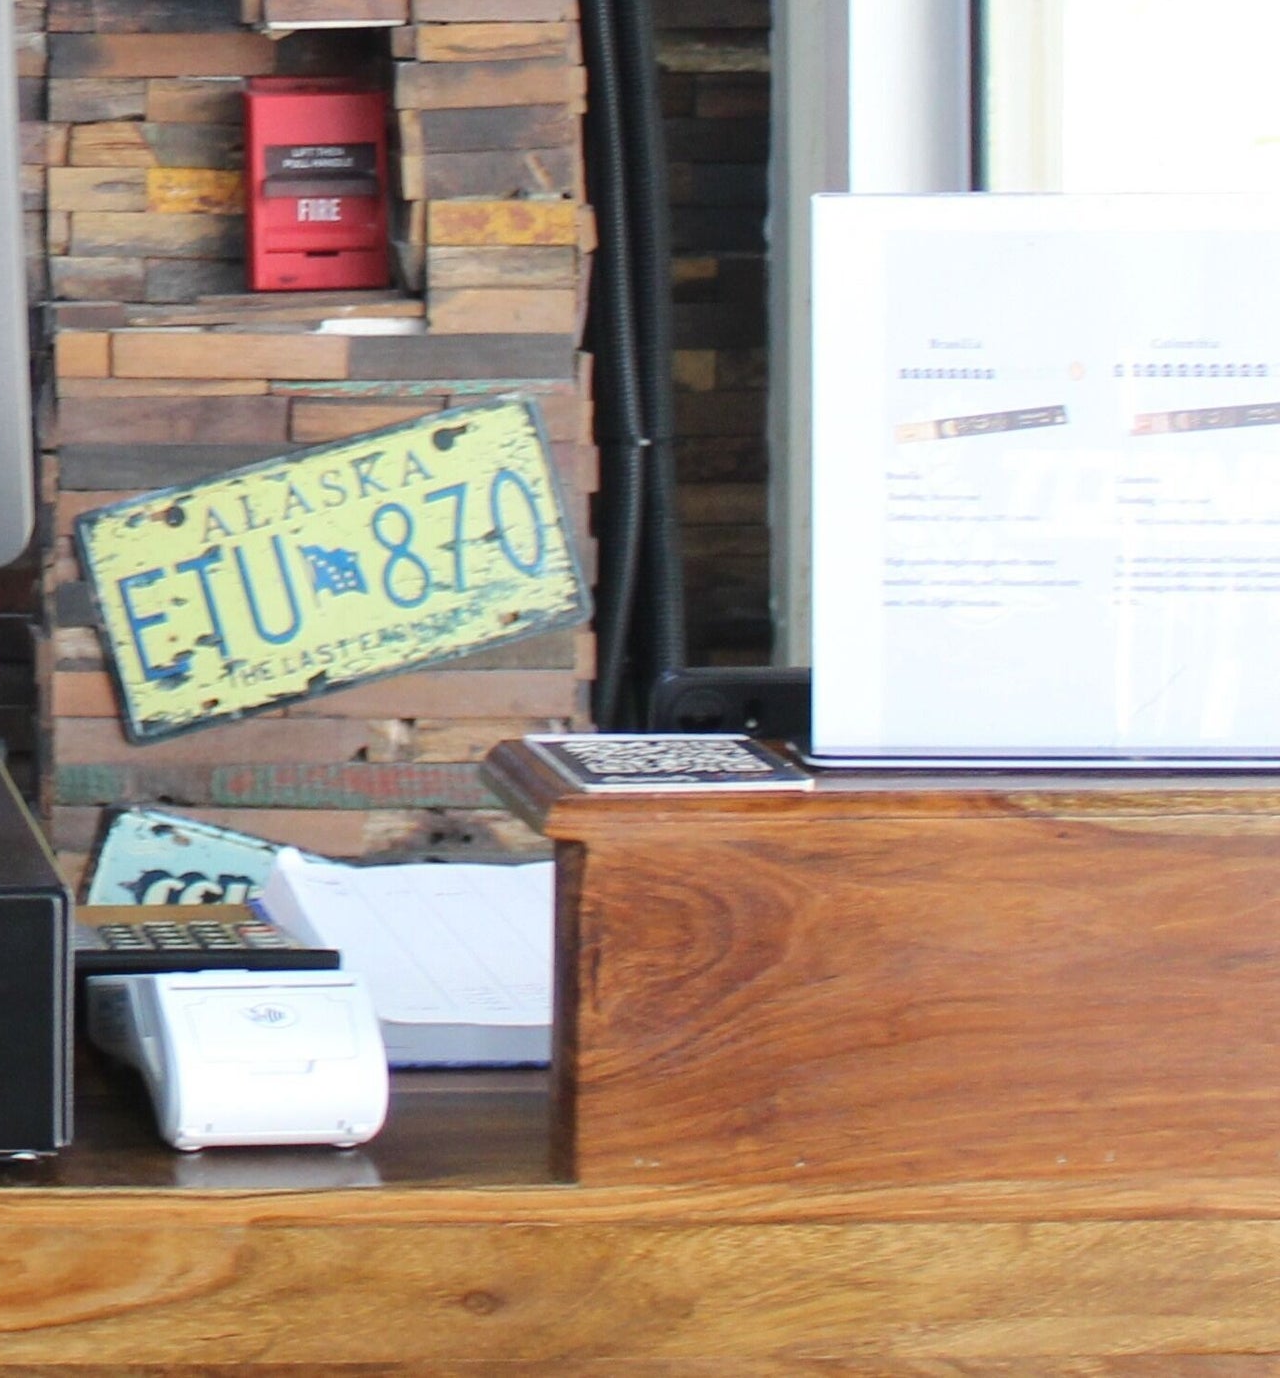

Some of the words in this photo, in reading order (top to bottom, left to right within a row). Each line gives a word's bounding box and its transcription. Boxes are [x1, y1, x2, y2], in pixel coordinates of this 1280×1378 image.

[296, 198, 342, 222] FIRE
[200, 448, 434, 545] ALASKA
[115, 532, 303, 683] ETU
[370, 466, 546, 610] 870
[225, 658, 273, 691] THE
[283, 634, 355, 677] LAST
